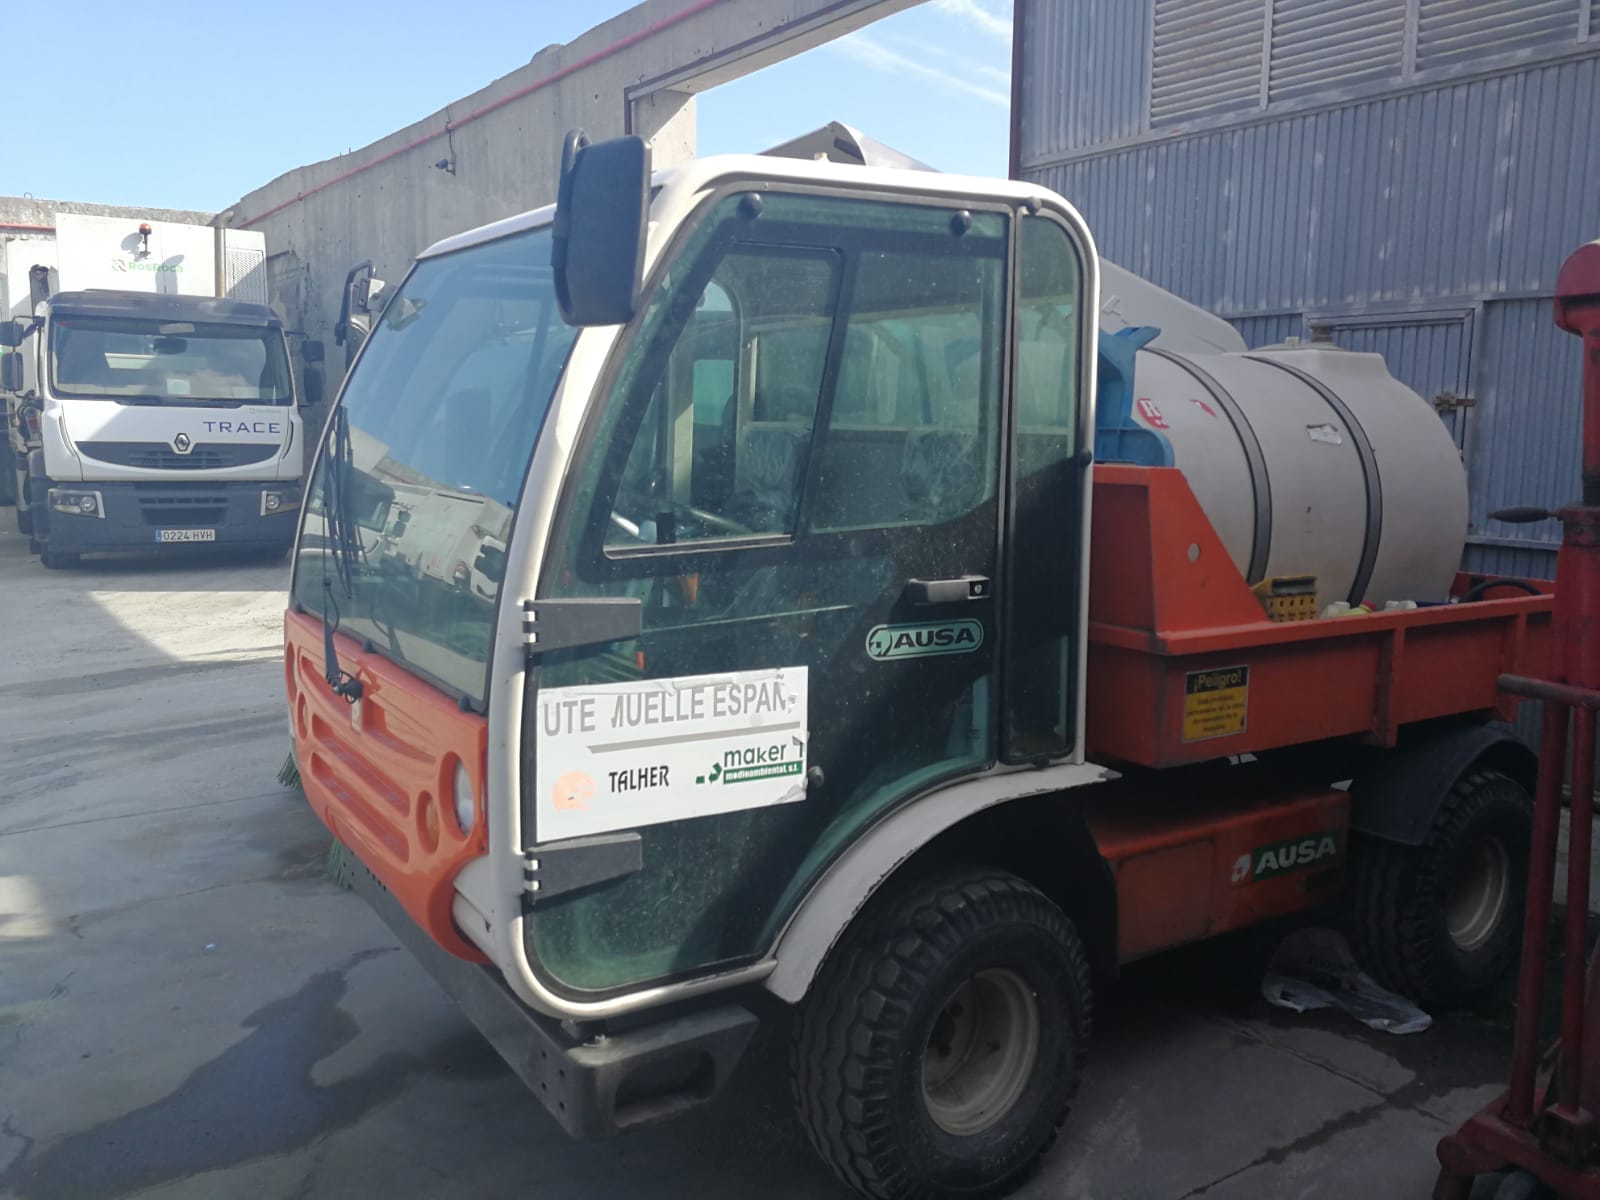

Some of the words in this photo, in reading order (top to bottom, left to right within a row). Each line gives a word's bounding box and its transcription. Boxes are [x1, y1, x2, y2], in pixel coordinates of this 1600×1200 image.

[203, 422, 280, 433] TRACE
[163, 531, 190, 541] 0224
[192, 530, 213, 540] HVH
[893, 627, 976, 649] AUSA
[544, 698, 596, 736] UTE
[724, 744, 787, 767] maker
[609, 765, 669, 793] TALHER
[1255, 837, 1337, 874] AUSA
